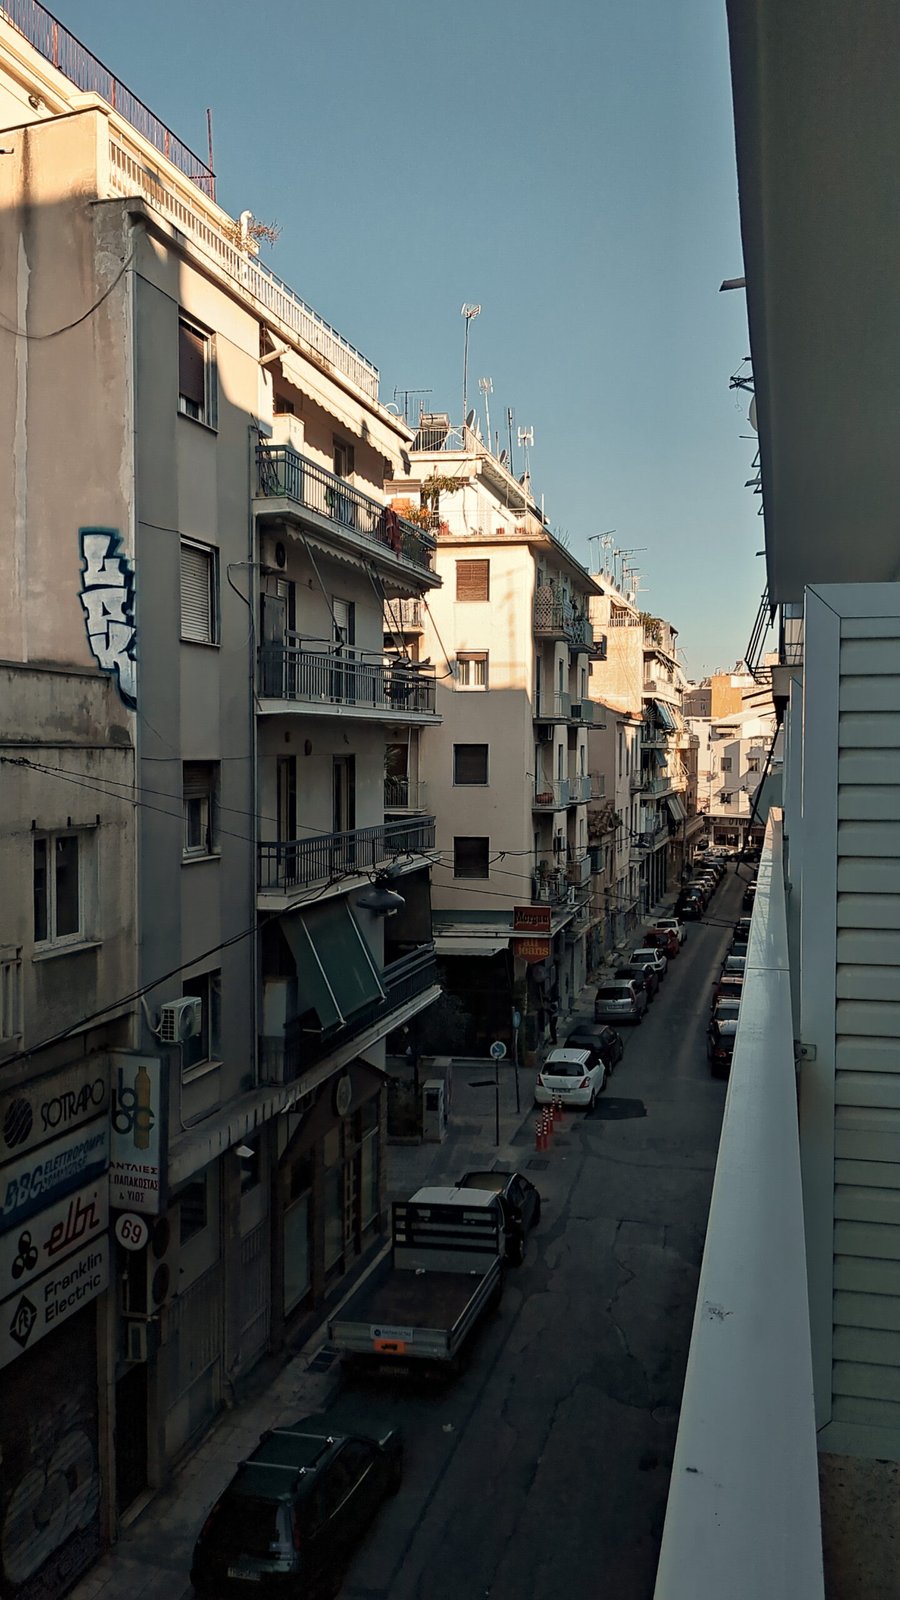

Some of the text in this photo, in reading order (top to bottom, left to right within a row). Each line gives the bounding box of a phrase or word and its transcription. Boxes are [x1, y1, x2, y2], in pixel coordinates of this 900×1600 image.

[41, 1078, 105, 1132] SOTRAPO
[43, 1131, 106, 1175] ELETTROPOMPE
[43, 1192, 100, 1257] elbi
[120, 1219, 142, 1244] 69
[44, 1252, 102, 1302] Franklin
[44, 1273, 101, 1324] Electric
